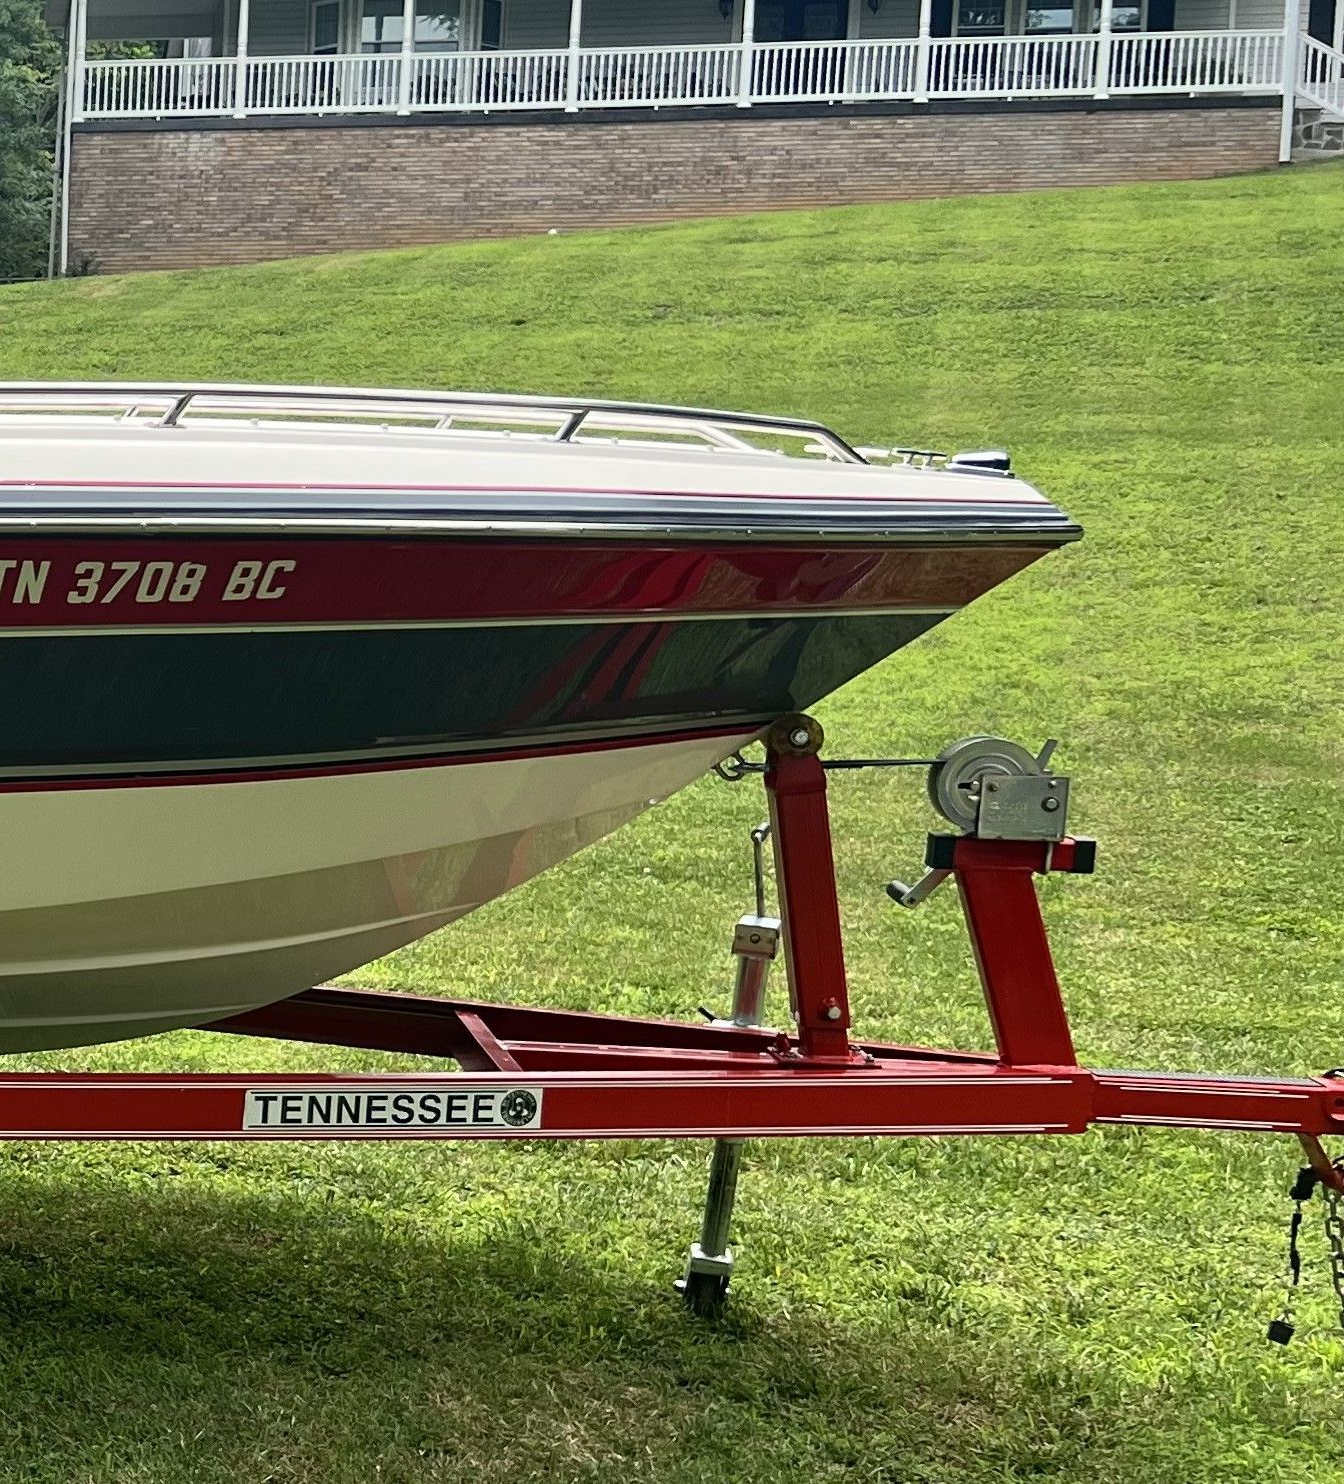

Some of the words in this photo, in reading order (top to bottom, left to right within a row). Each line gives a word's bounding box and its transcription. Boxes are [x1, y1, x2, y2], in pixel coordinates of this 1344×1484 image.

[67, 560, 208, 604] 3708
[222, 559, 297, 602] BC
[254, 1094, 496, 1124] TENNESSEE
